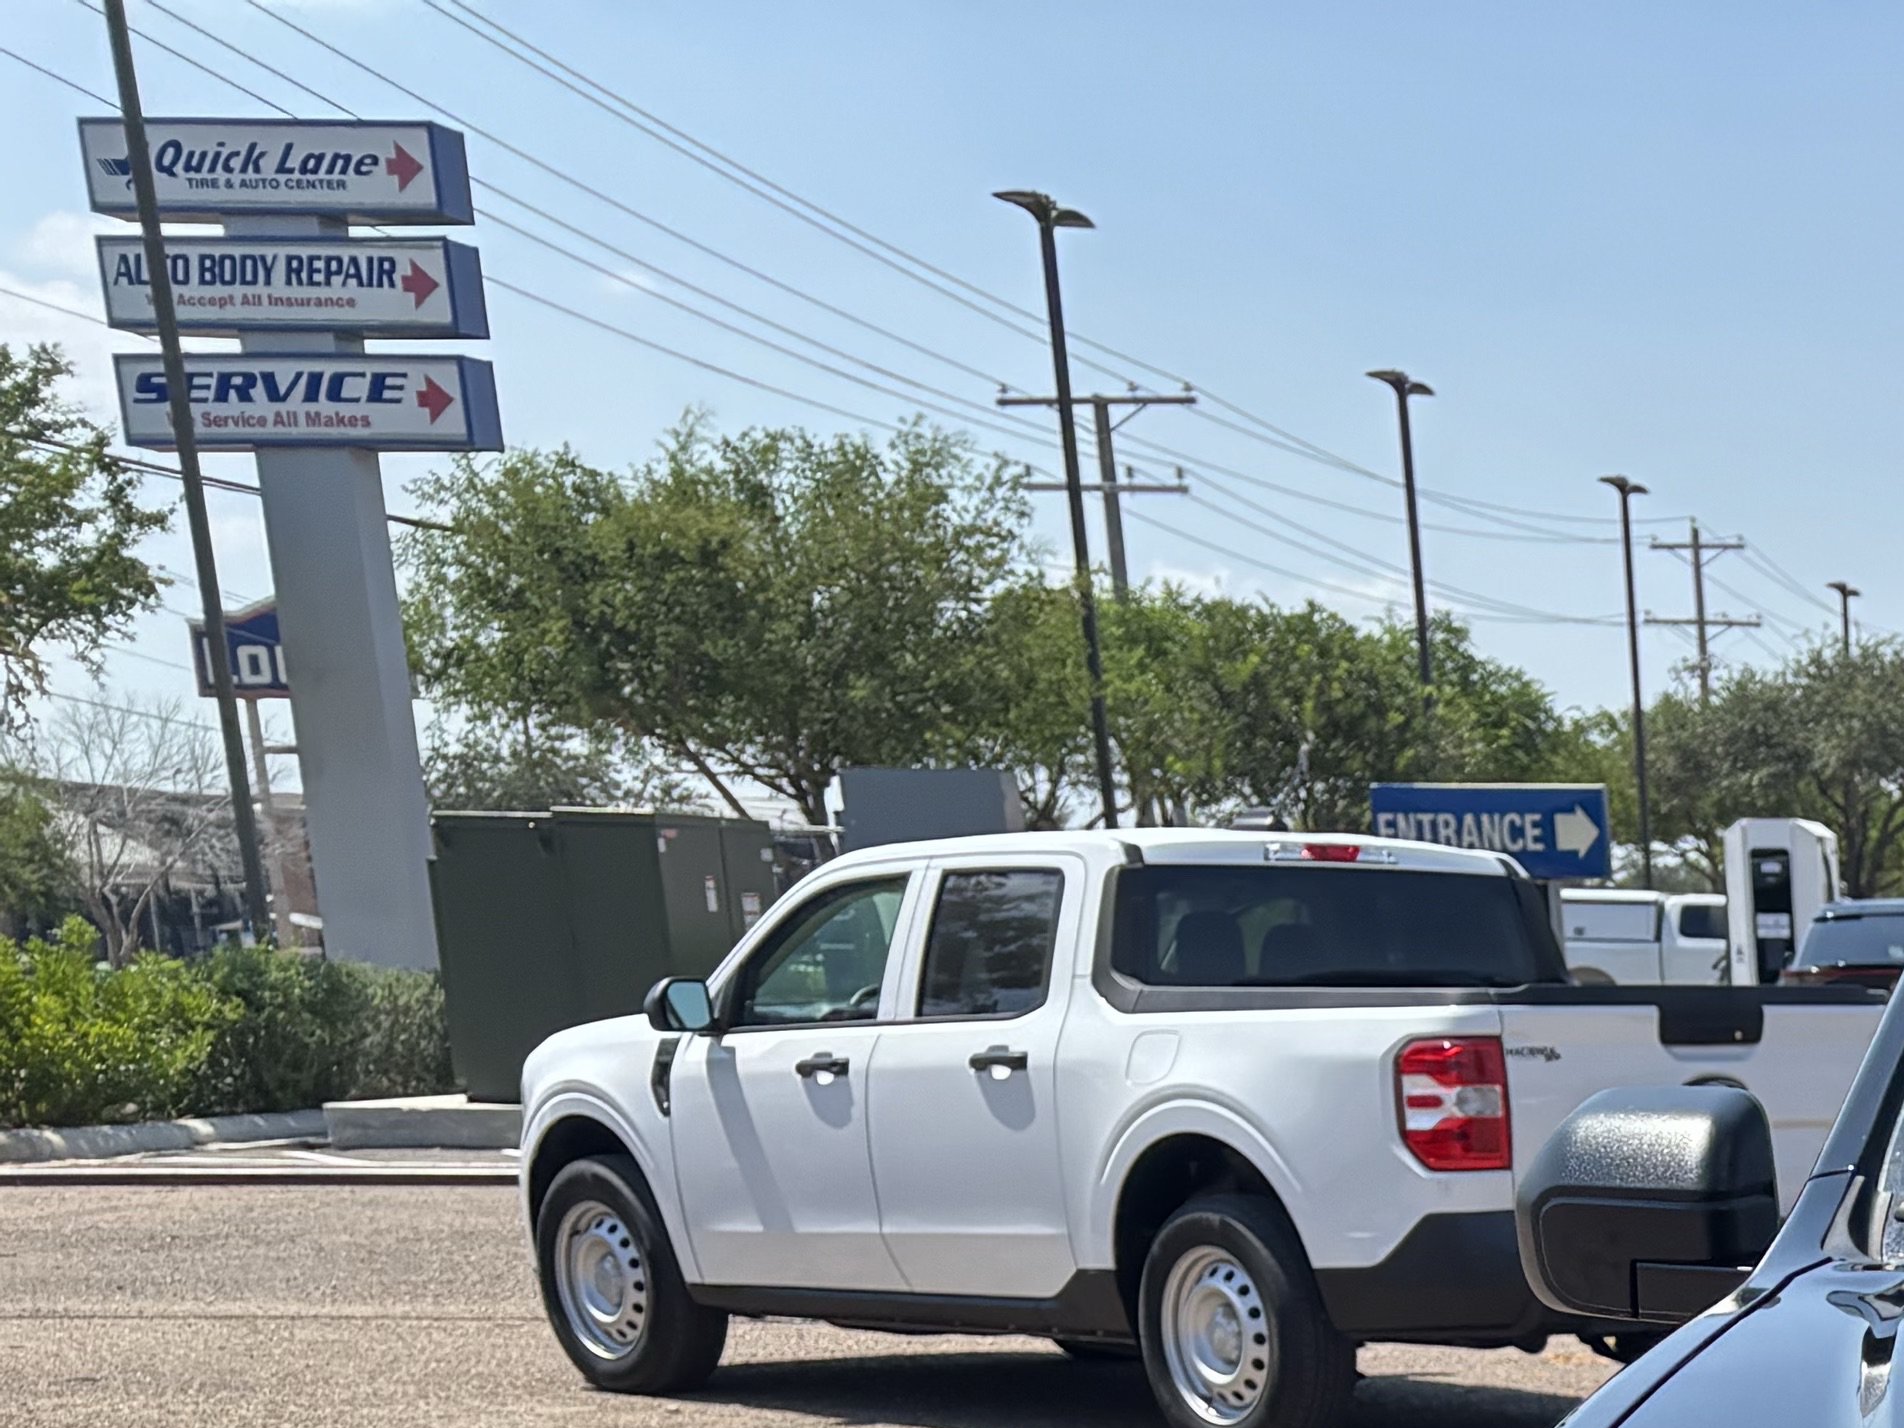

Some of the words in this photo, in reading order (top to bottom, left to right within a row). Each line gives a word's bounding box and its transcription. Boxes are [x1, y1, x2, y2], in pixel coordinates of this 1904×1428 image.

[154, 139, 268, 178] Quick
[274, 141, 380, 177] Lane
[185, 177, 220, 190] TIRE
[224, 178, 235, 190] &
[239, 178, 280, 190] AUTO
[284, 178, 348, 191] CENTER
[113, 253, 190, 286] AUO
[198, 254, 278, 287] BODY
[285, 255, 397, 289] REPAIR
[177, 293, 236, 309] Accept
[267, 294, 357, 309] Insurance
[133, 371, 408, 404] SERVICE
[201, 411, 267, 428] Service
[272, 411, 299, 428] All
[304, 412, 372, 428] Makes
[1377, 812, 1546, 851] ENTRANCE
